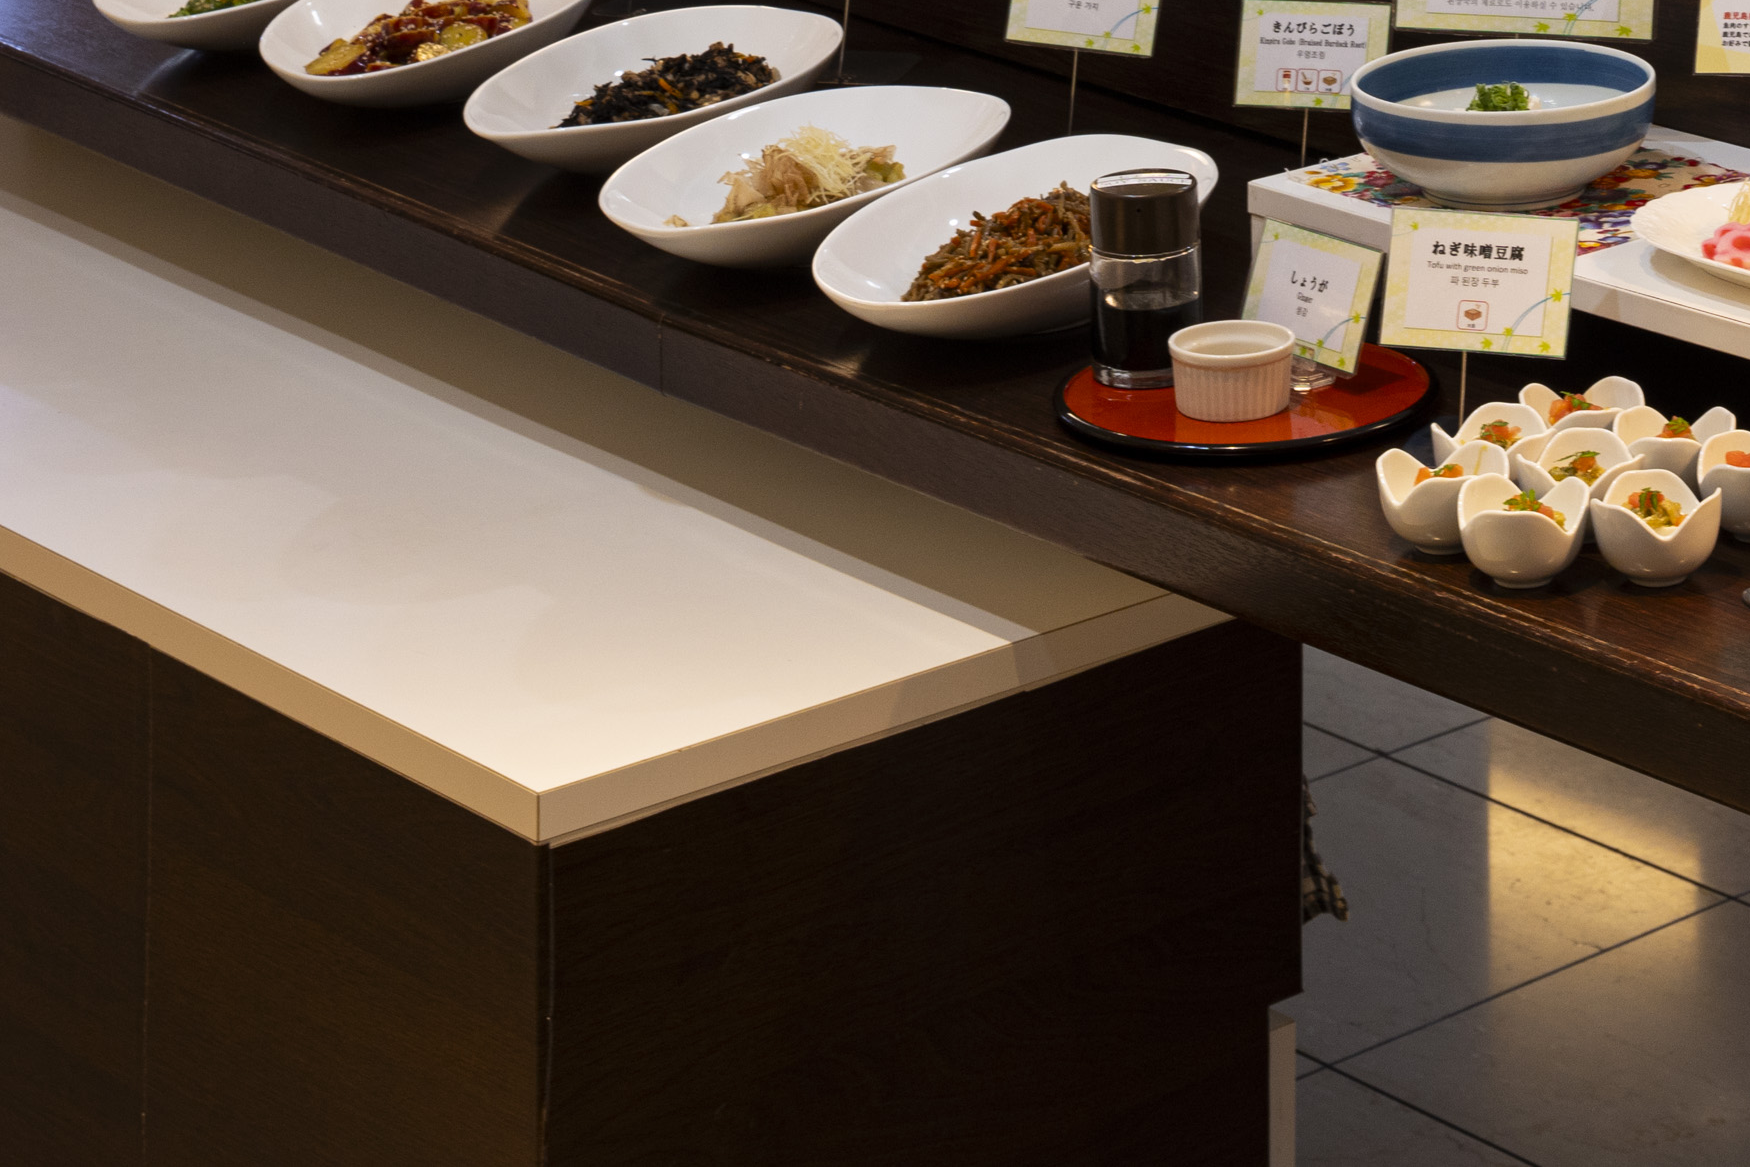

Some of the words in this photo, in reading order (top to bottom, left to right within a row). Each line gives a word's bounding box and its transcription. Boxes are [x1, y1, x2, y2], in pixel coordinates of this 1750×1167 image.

[1273, 21, 1355, 37] きんぴらごぼう
[1432, 241, 1525, 262] ねぎ味噌豆腐
[1427, 260, 1444, 270] Tofu
[1446, 261, 1462, 271] with
[1463, 264, 1485, 273] green
[1487, 265, 1508, 274] onion
[1510, 266, 1529, 275] miso
[1291, 270, 1329, 293] しょうが
[1462, 277, 1480, 288] 된장
[1482, 278, 1500, 289] 두부
